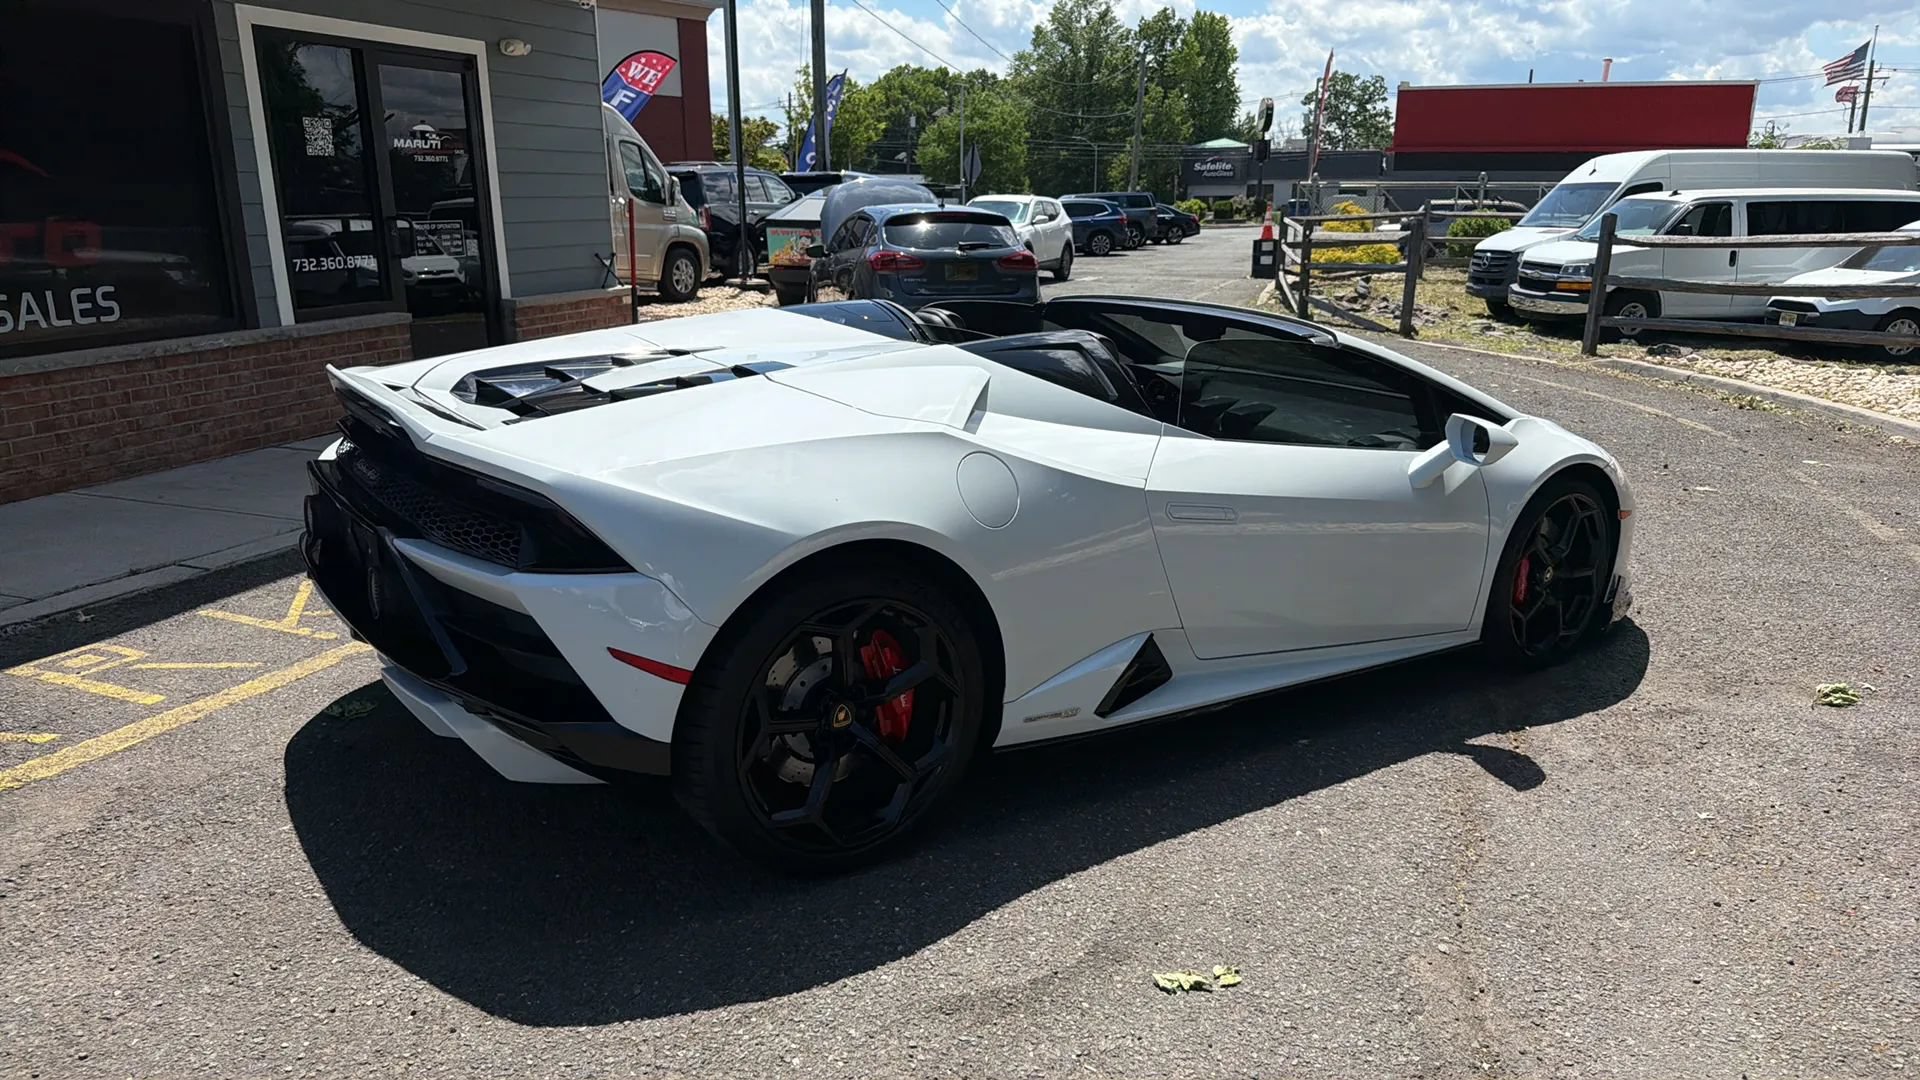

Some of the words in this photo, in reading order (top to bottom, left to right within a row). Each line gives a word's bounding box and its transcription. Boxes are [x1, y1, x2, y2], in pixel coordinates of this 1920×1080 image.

[627, 61, 662, 86] WE
[610, 89, 637, 107] F
[393, 138, 441, 149] MARUTI
[1193, 161, 1232, 171] Safelite
[292, 255, 376, 272] 732.360.8771
